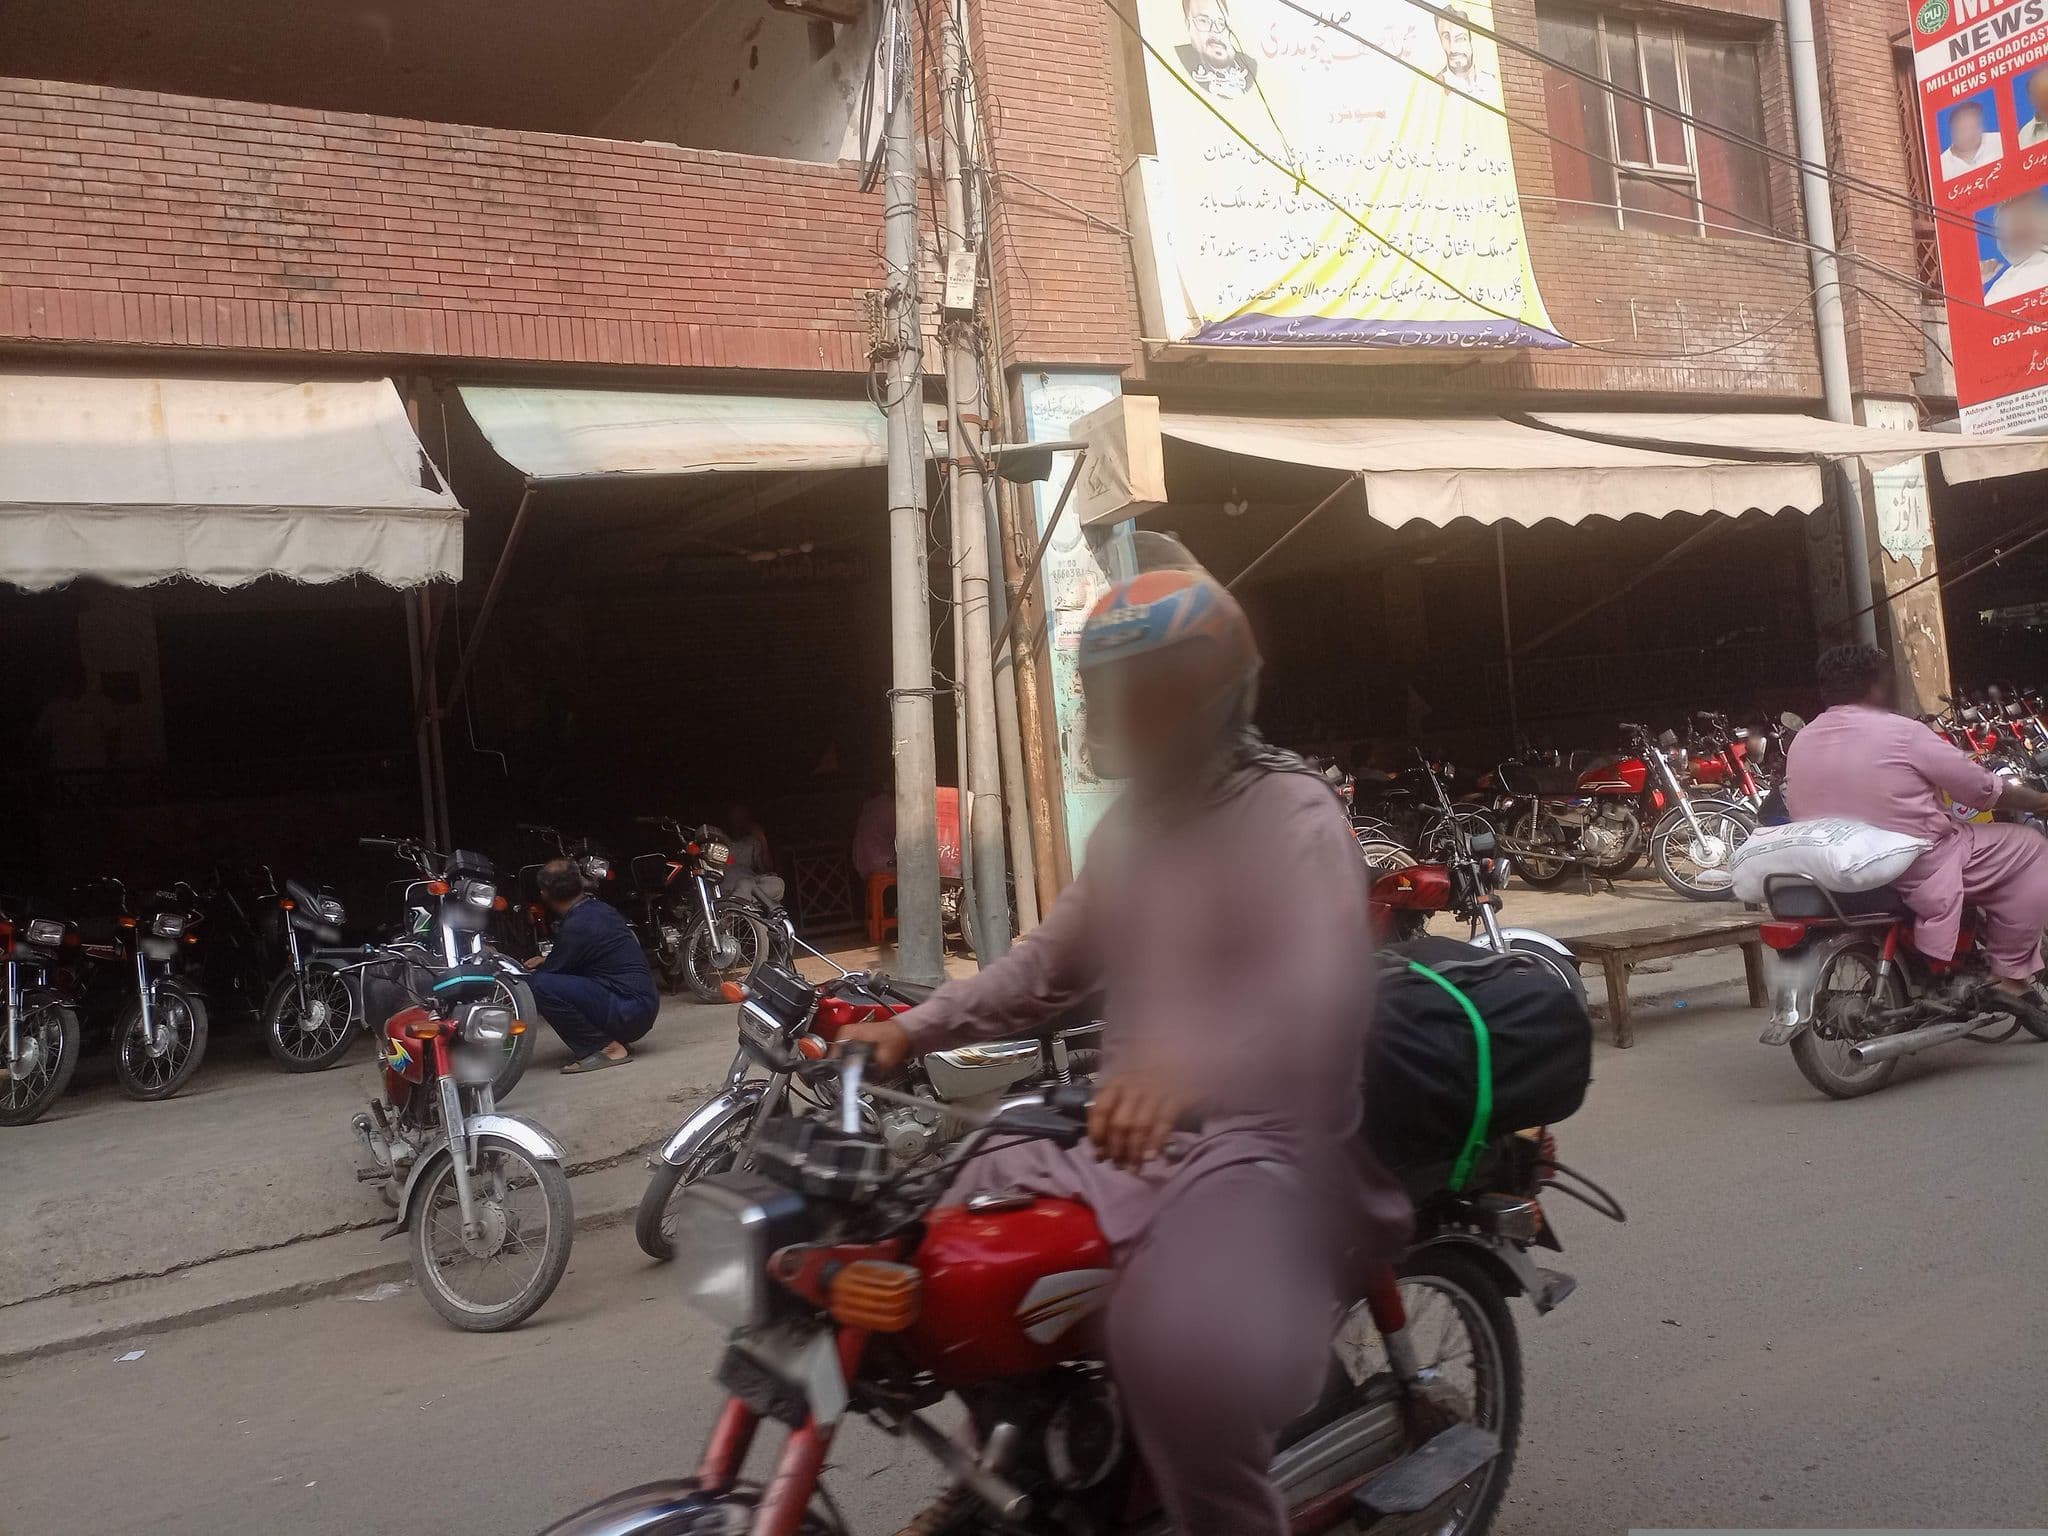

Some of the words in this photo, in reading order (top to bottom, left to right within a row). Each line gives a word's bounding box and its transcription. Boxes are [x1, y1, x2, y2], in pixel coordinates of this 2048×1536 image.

[1948, 0, 2045, 63] NEWS
[1926, 61, 1976, 94] MILLION
[1951, 71, 1988, 98] NEWS
